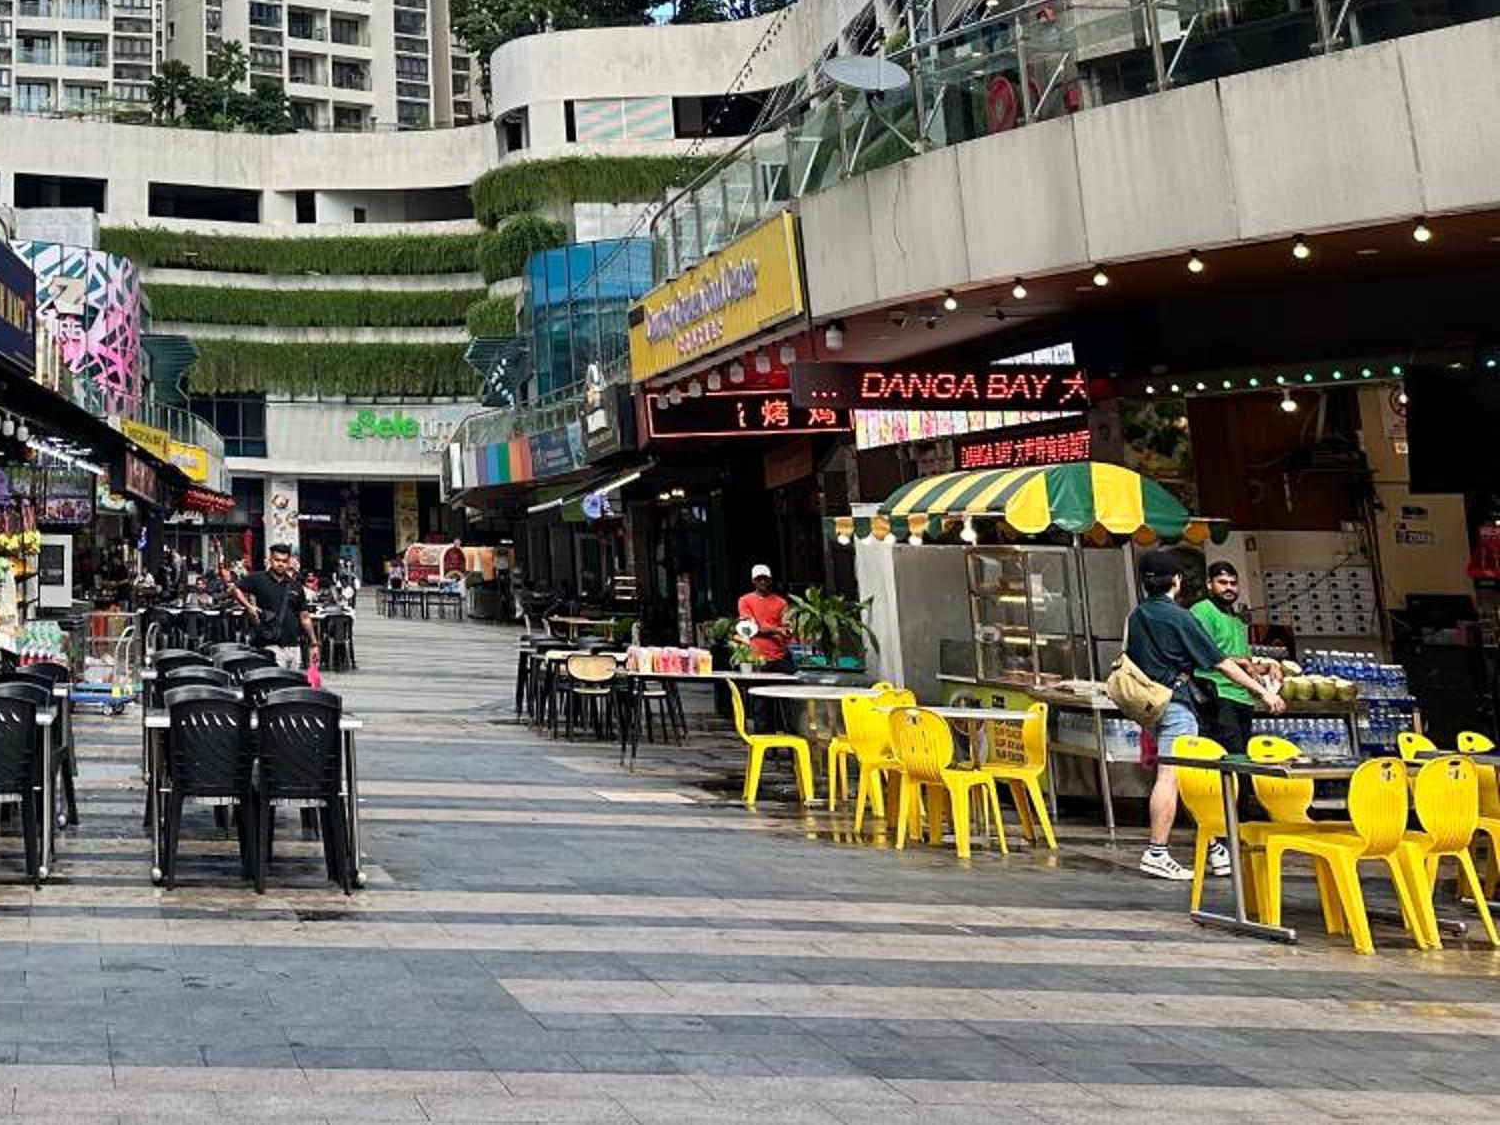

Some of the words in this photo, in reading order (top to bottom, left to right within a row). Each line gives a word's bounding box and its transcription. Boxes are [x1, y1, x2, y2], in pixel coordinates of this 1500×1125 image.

[861, 372, 979, 399] DANGA
[986, 373, 1052, 400] BAY
[1058, 371, 1088, 405] 大
